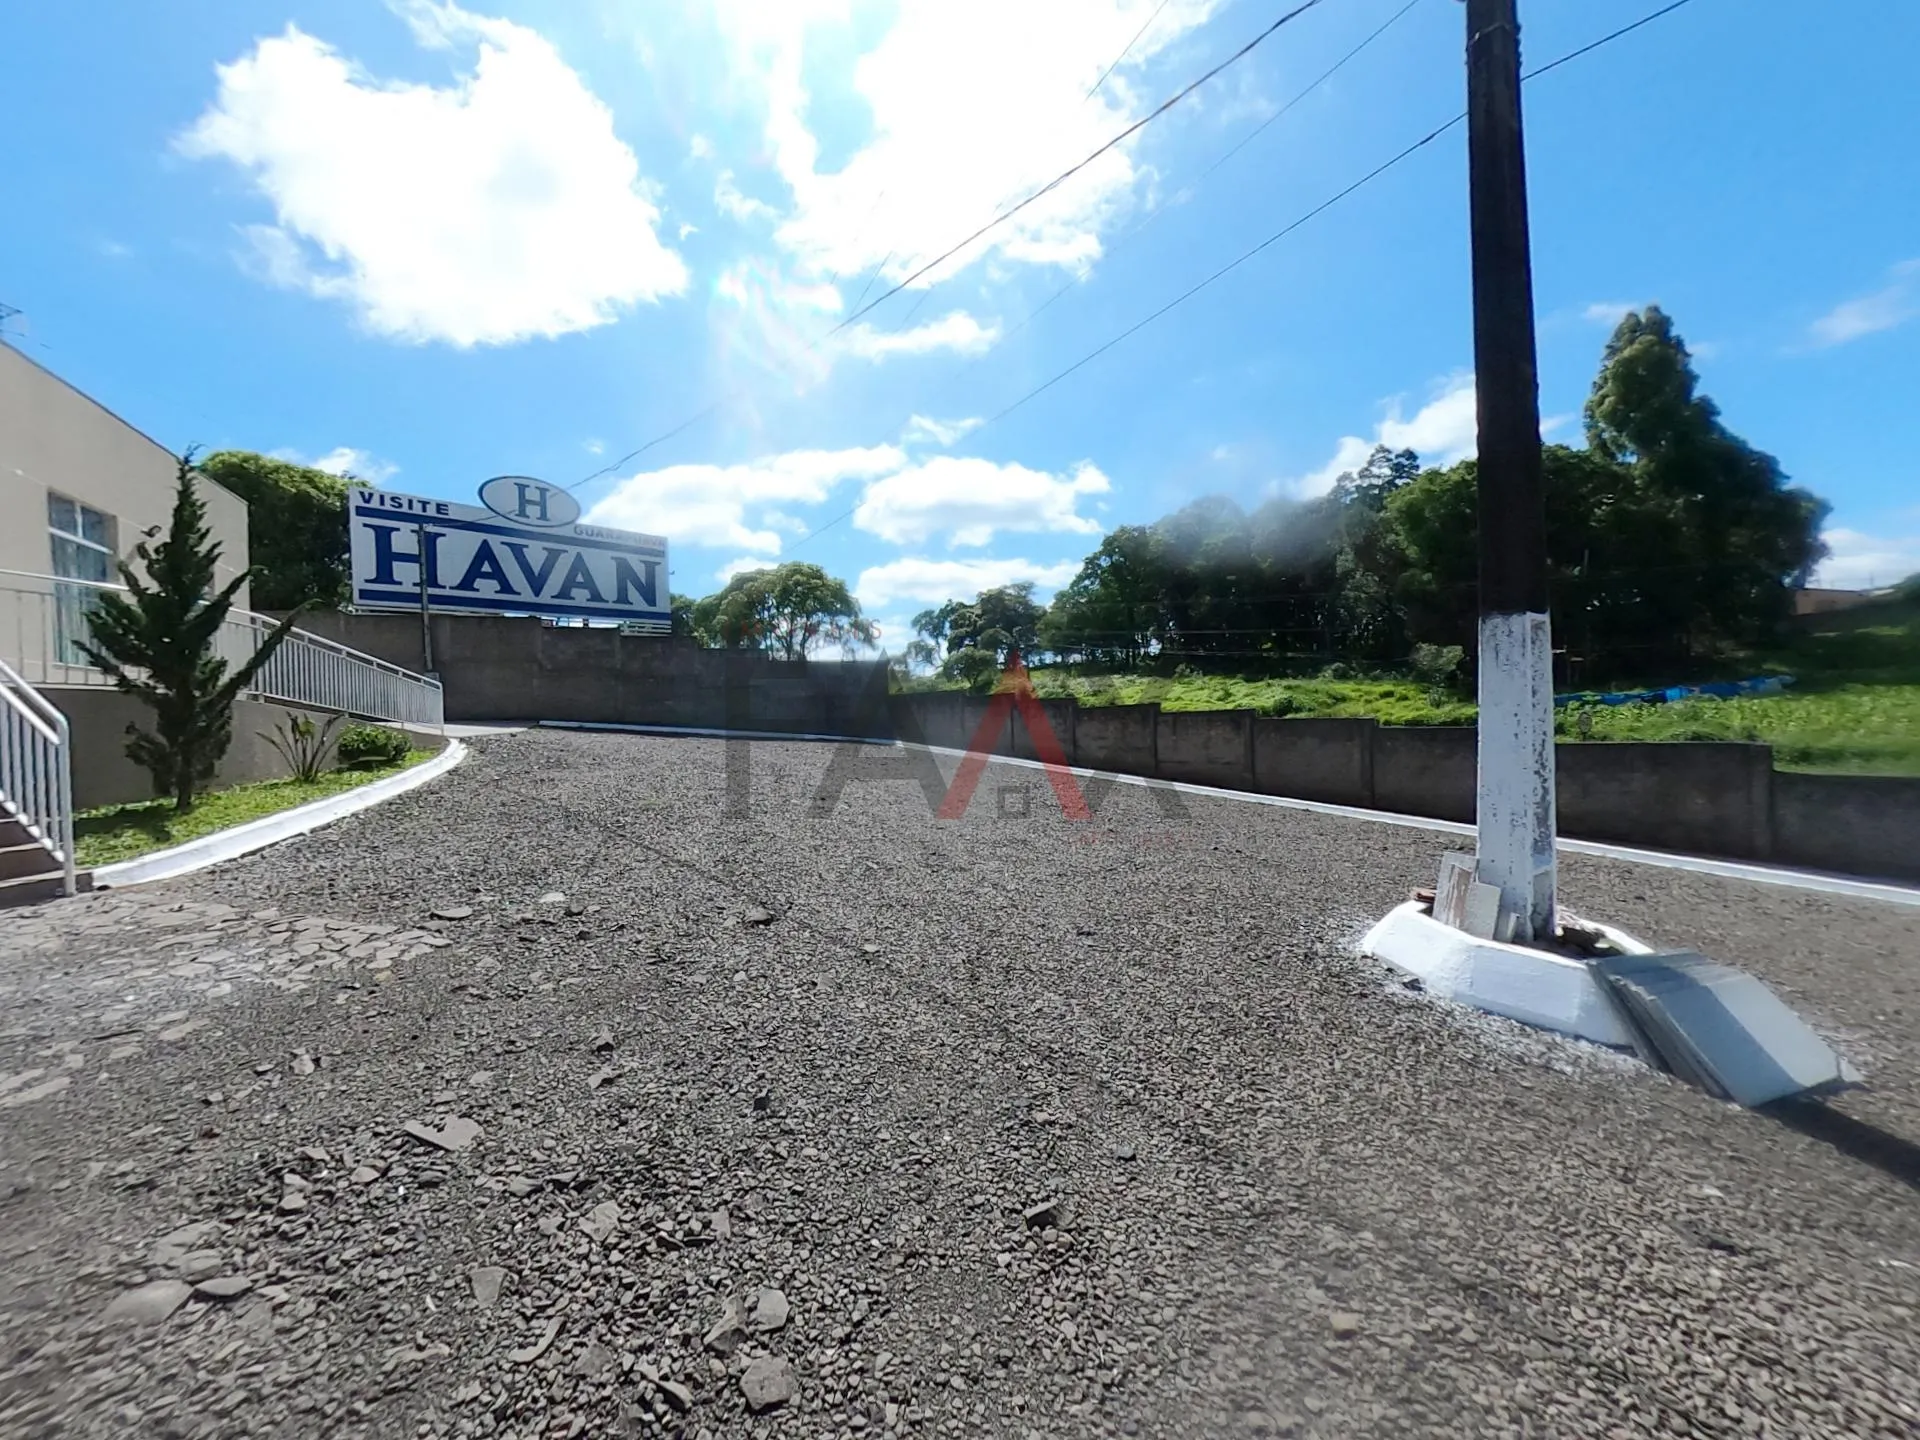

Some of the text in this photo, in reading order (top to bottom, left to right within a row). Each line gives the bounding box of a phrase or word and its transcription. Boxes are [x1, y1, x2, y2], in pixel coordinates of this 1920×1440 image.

[358, 490, 451, 516] VISITE
[513, 481, 553, 522] H
[362, 522, 662, 608] HAVAN
